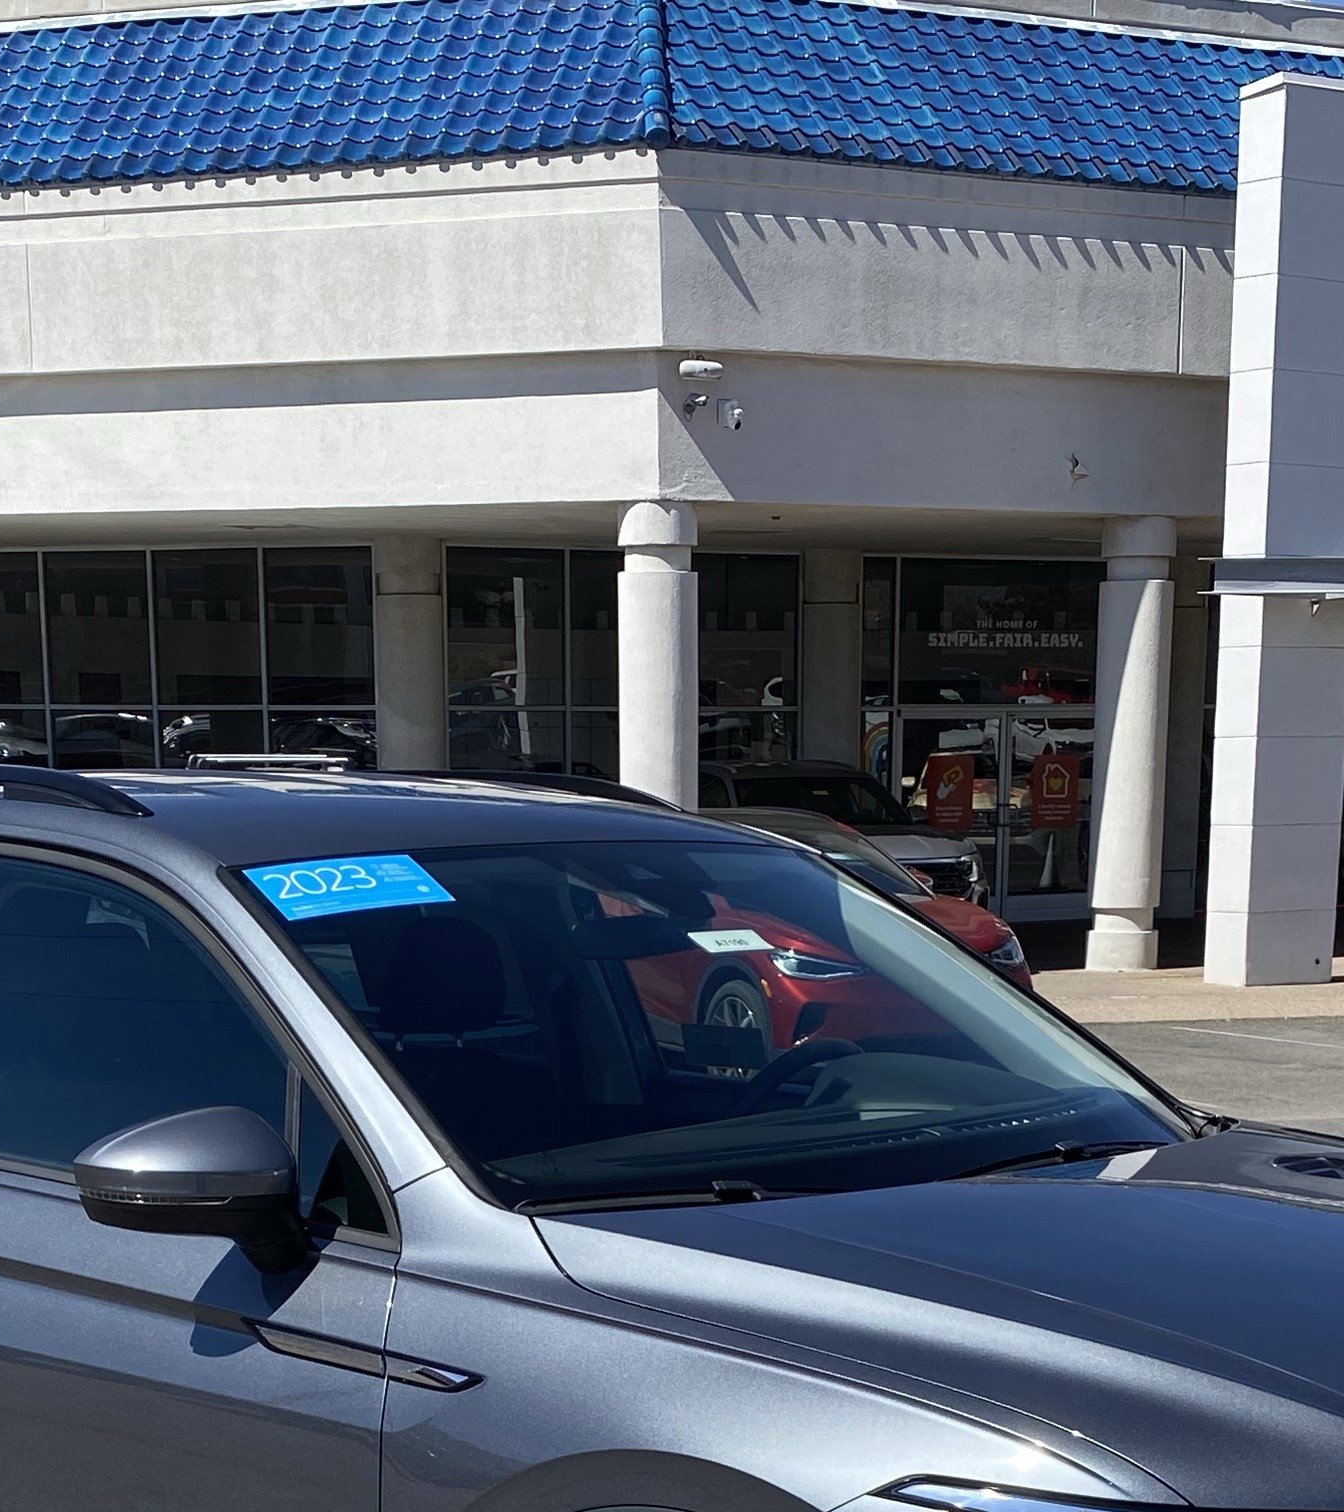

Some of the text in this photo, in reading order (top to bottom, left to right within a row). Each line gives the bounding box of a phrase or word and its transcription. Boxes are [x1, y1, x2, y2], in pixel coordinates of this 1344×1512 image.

[976, 620, 1038, 629] THE HOME OF
[262, 865, 378, 899] 2023
